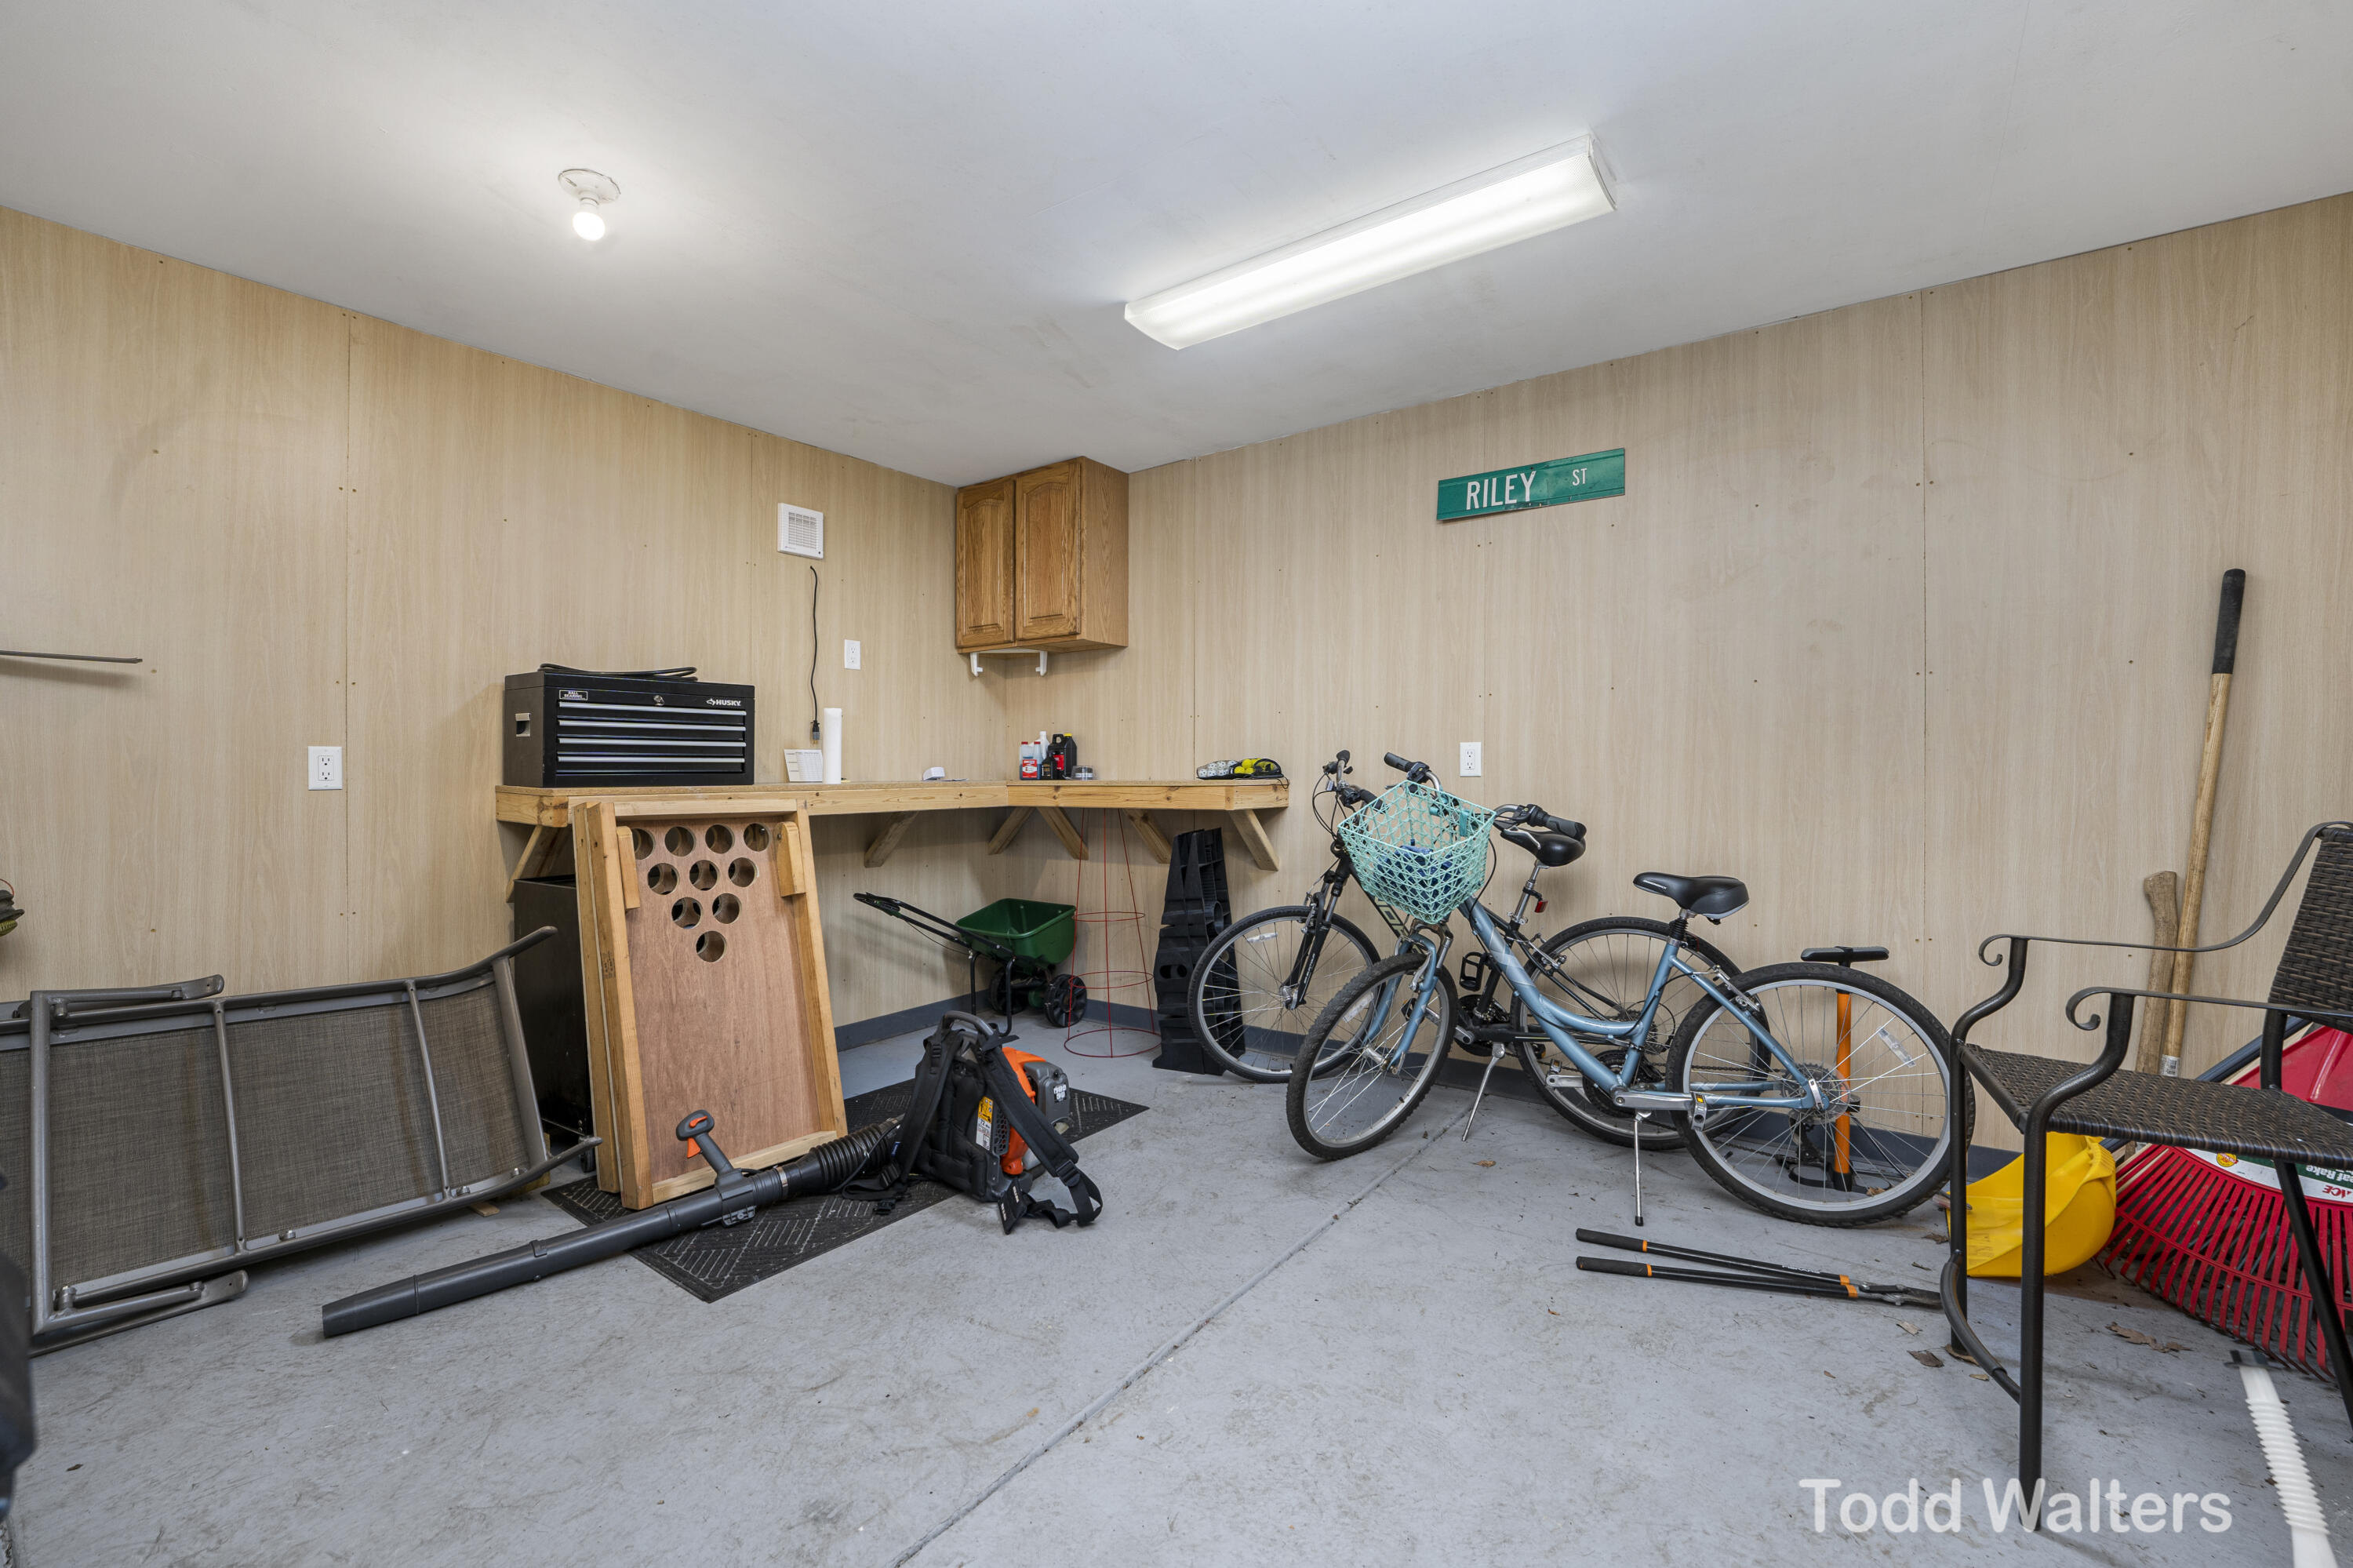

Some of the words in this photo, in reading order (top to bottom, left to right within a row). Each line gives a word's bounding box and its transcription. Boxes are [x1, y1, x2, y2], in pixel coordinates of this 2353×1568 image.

[1466, 471, 1537, 510] RILEY
[1572, 467, 1588, 486] ST
[2306, 1165, 2337, 1180] Rake
[2322, 1184, 2352, 1199] ACE
